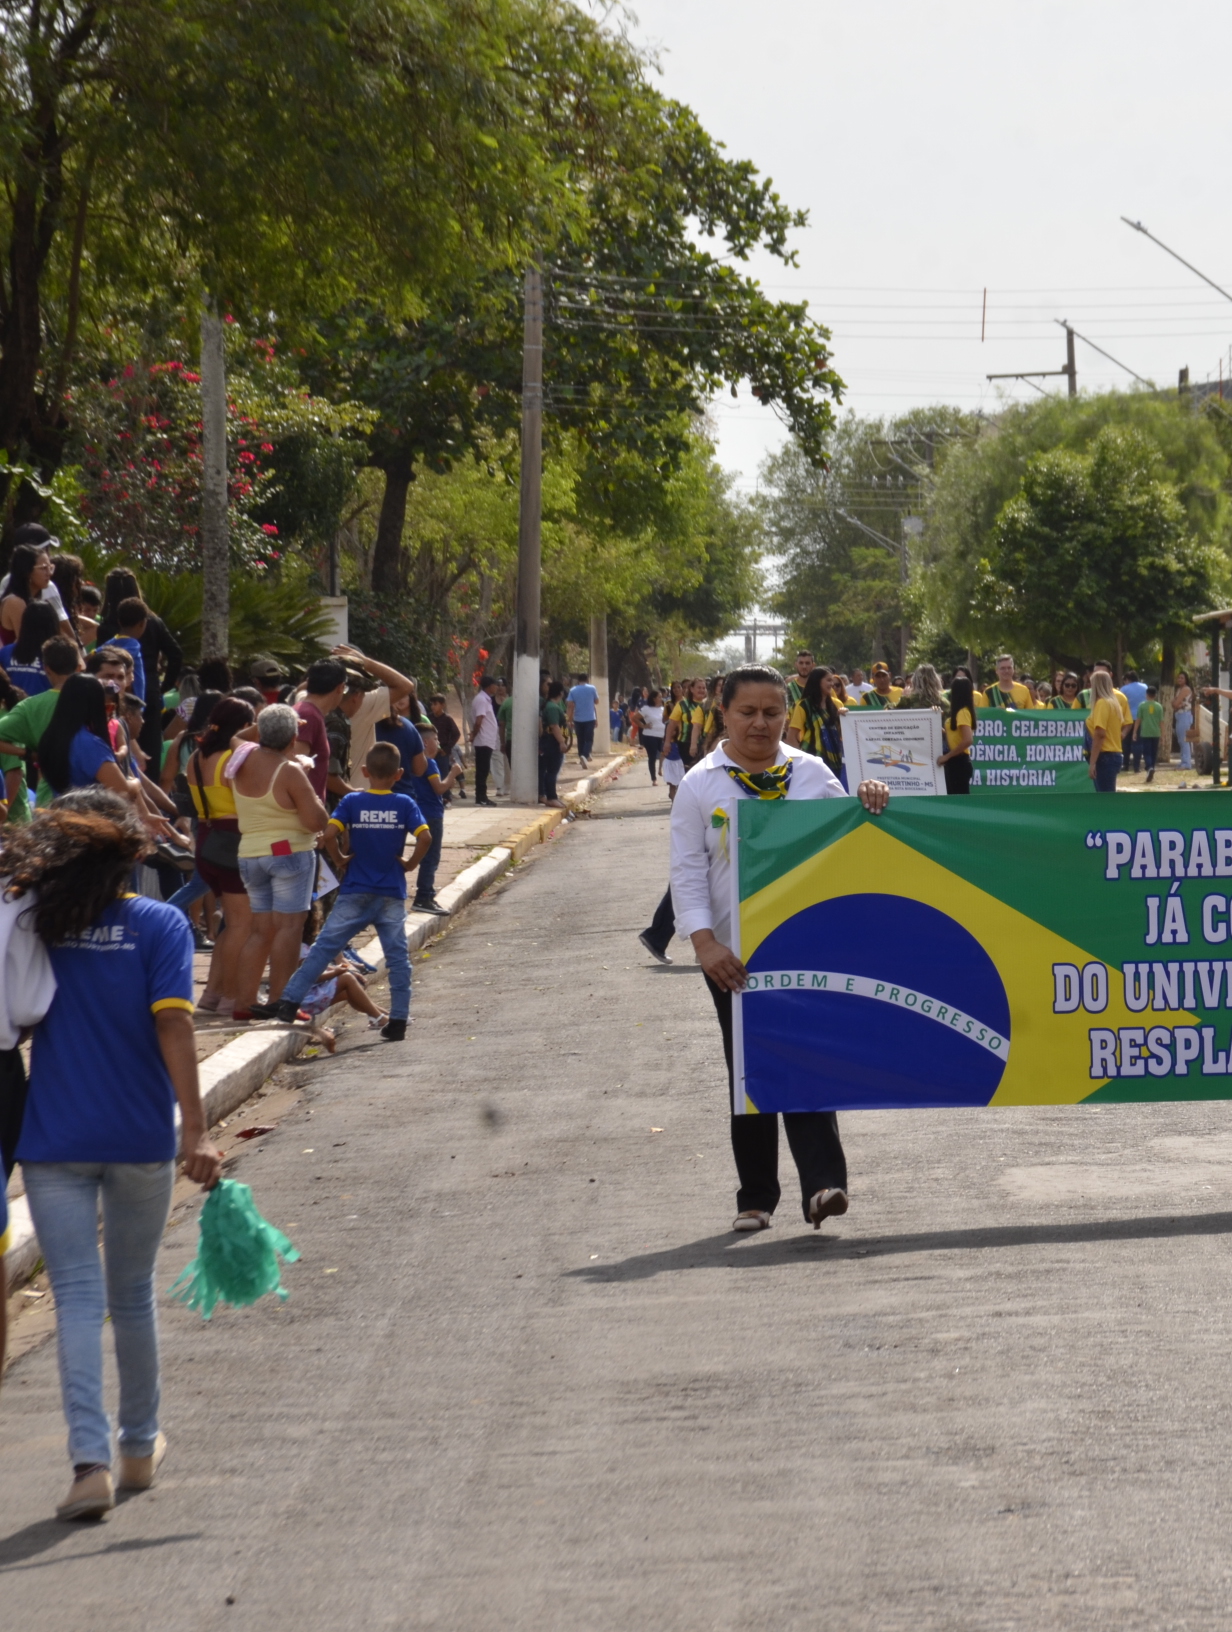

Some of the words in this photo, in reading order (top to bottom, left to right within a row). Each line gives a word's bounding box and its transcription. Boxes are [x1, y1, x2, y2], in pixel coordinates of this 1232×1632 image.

[972, 720, 1007, 737] BRO:
[1026, 745, 1087, 761] HONRAN
[986, 765, 1056, 786] HISTÓRIA!
[360, 810, 398, 823] REME
[1145, 881, 1189, 944] JÁ
[1053, 961, 1108, 1014] DO
[746, 973, 828, 990] ORDEM
[846, 977, 855, 992] E
[874, 983, 1003, 1050] PROGRESSO
